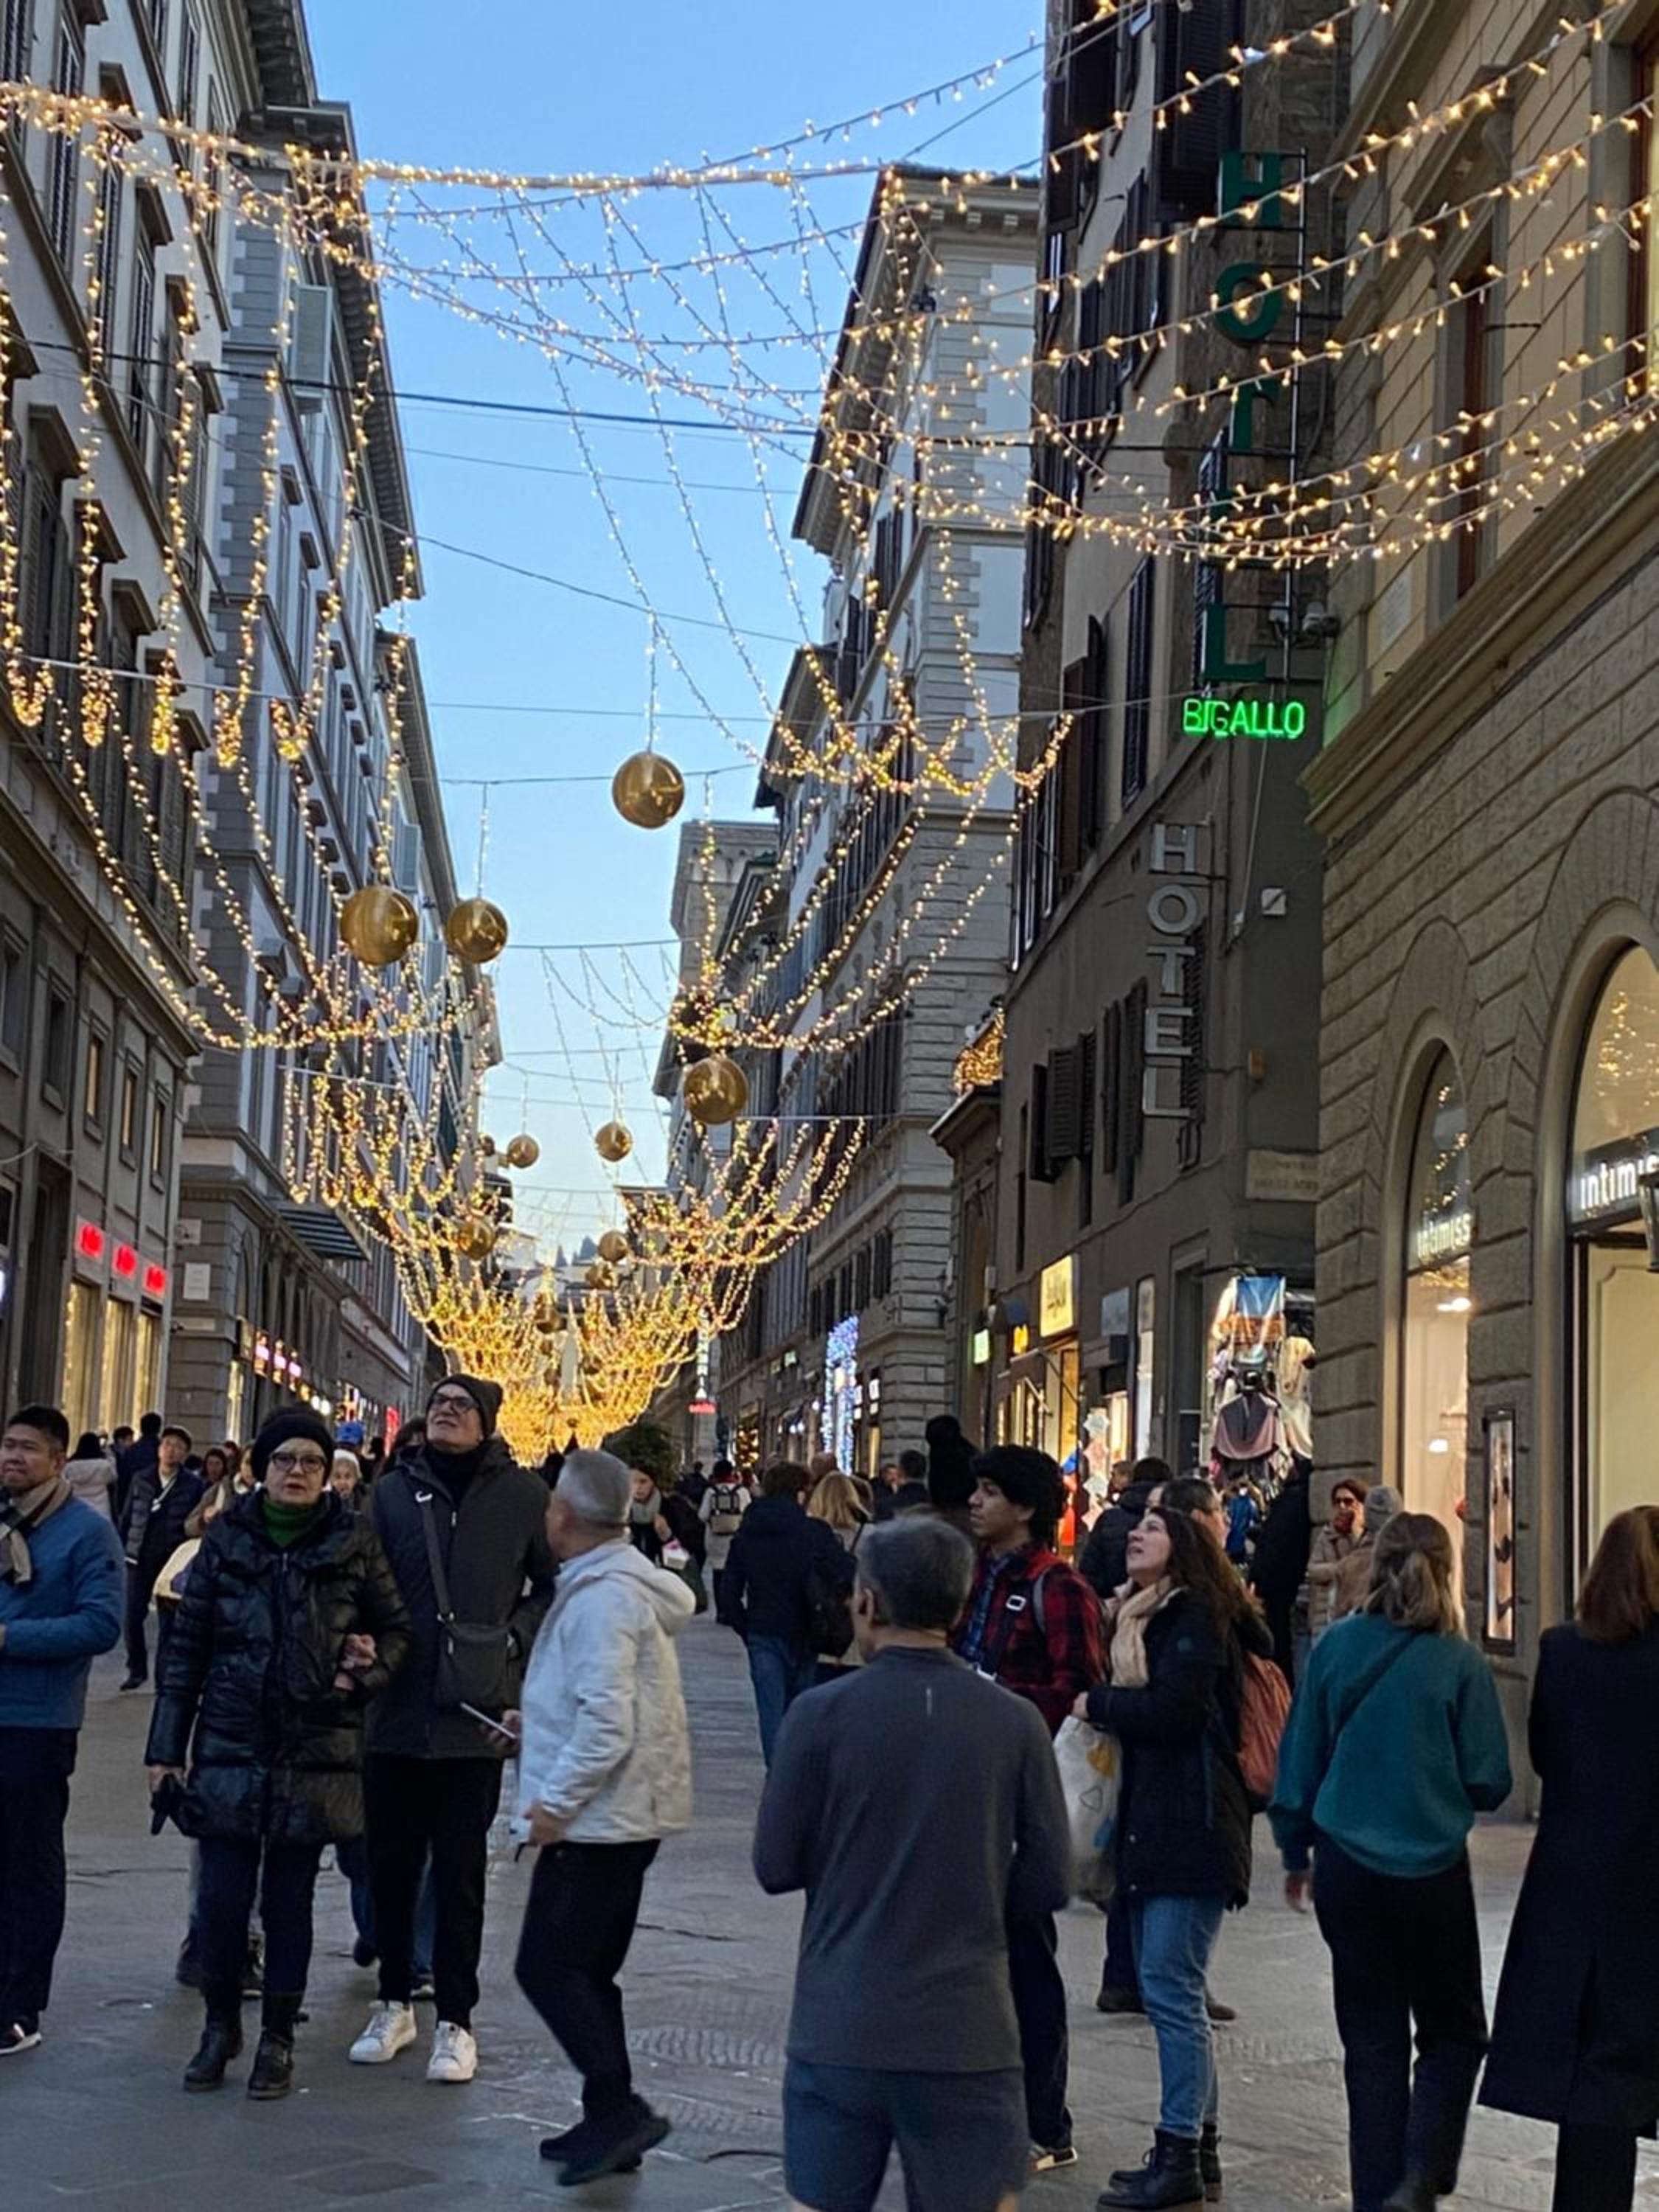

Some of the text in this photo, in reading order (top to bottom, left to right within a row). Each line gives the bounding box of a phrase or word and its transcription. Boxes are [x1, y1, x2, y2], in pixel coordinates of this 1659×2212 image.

[1203, 150, 1282, 682] HOTL
[1183, 698, 1305, 739] BIGALLO
[1143, 823, 1198, 1118] HOTEL
